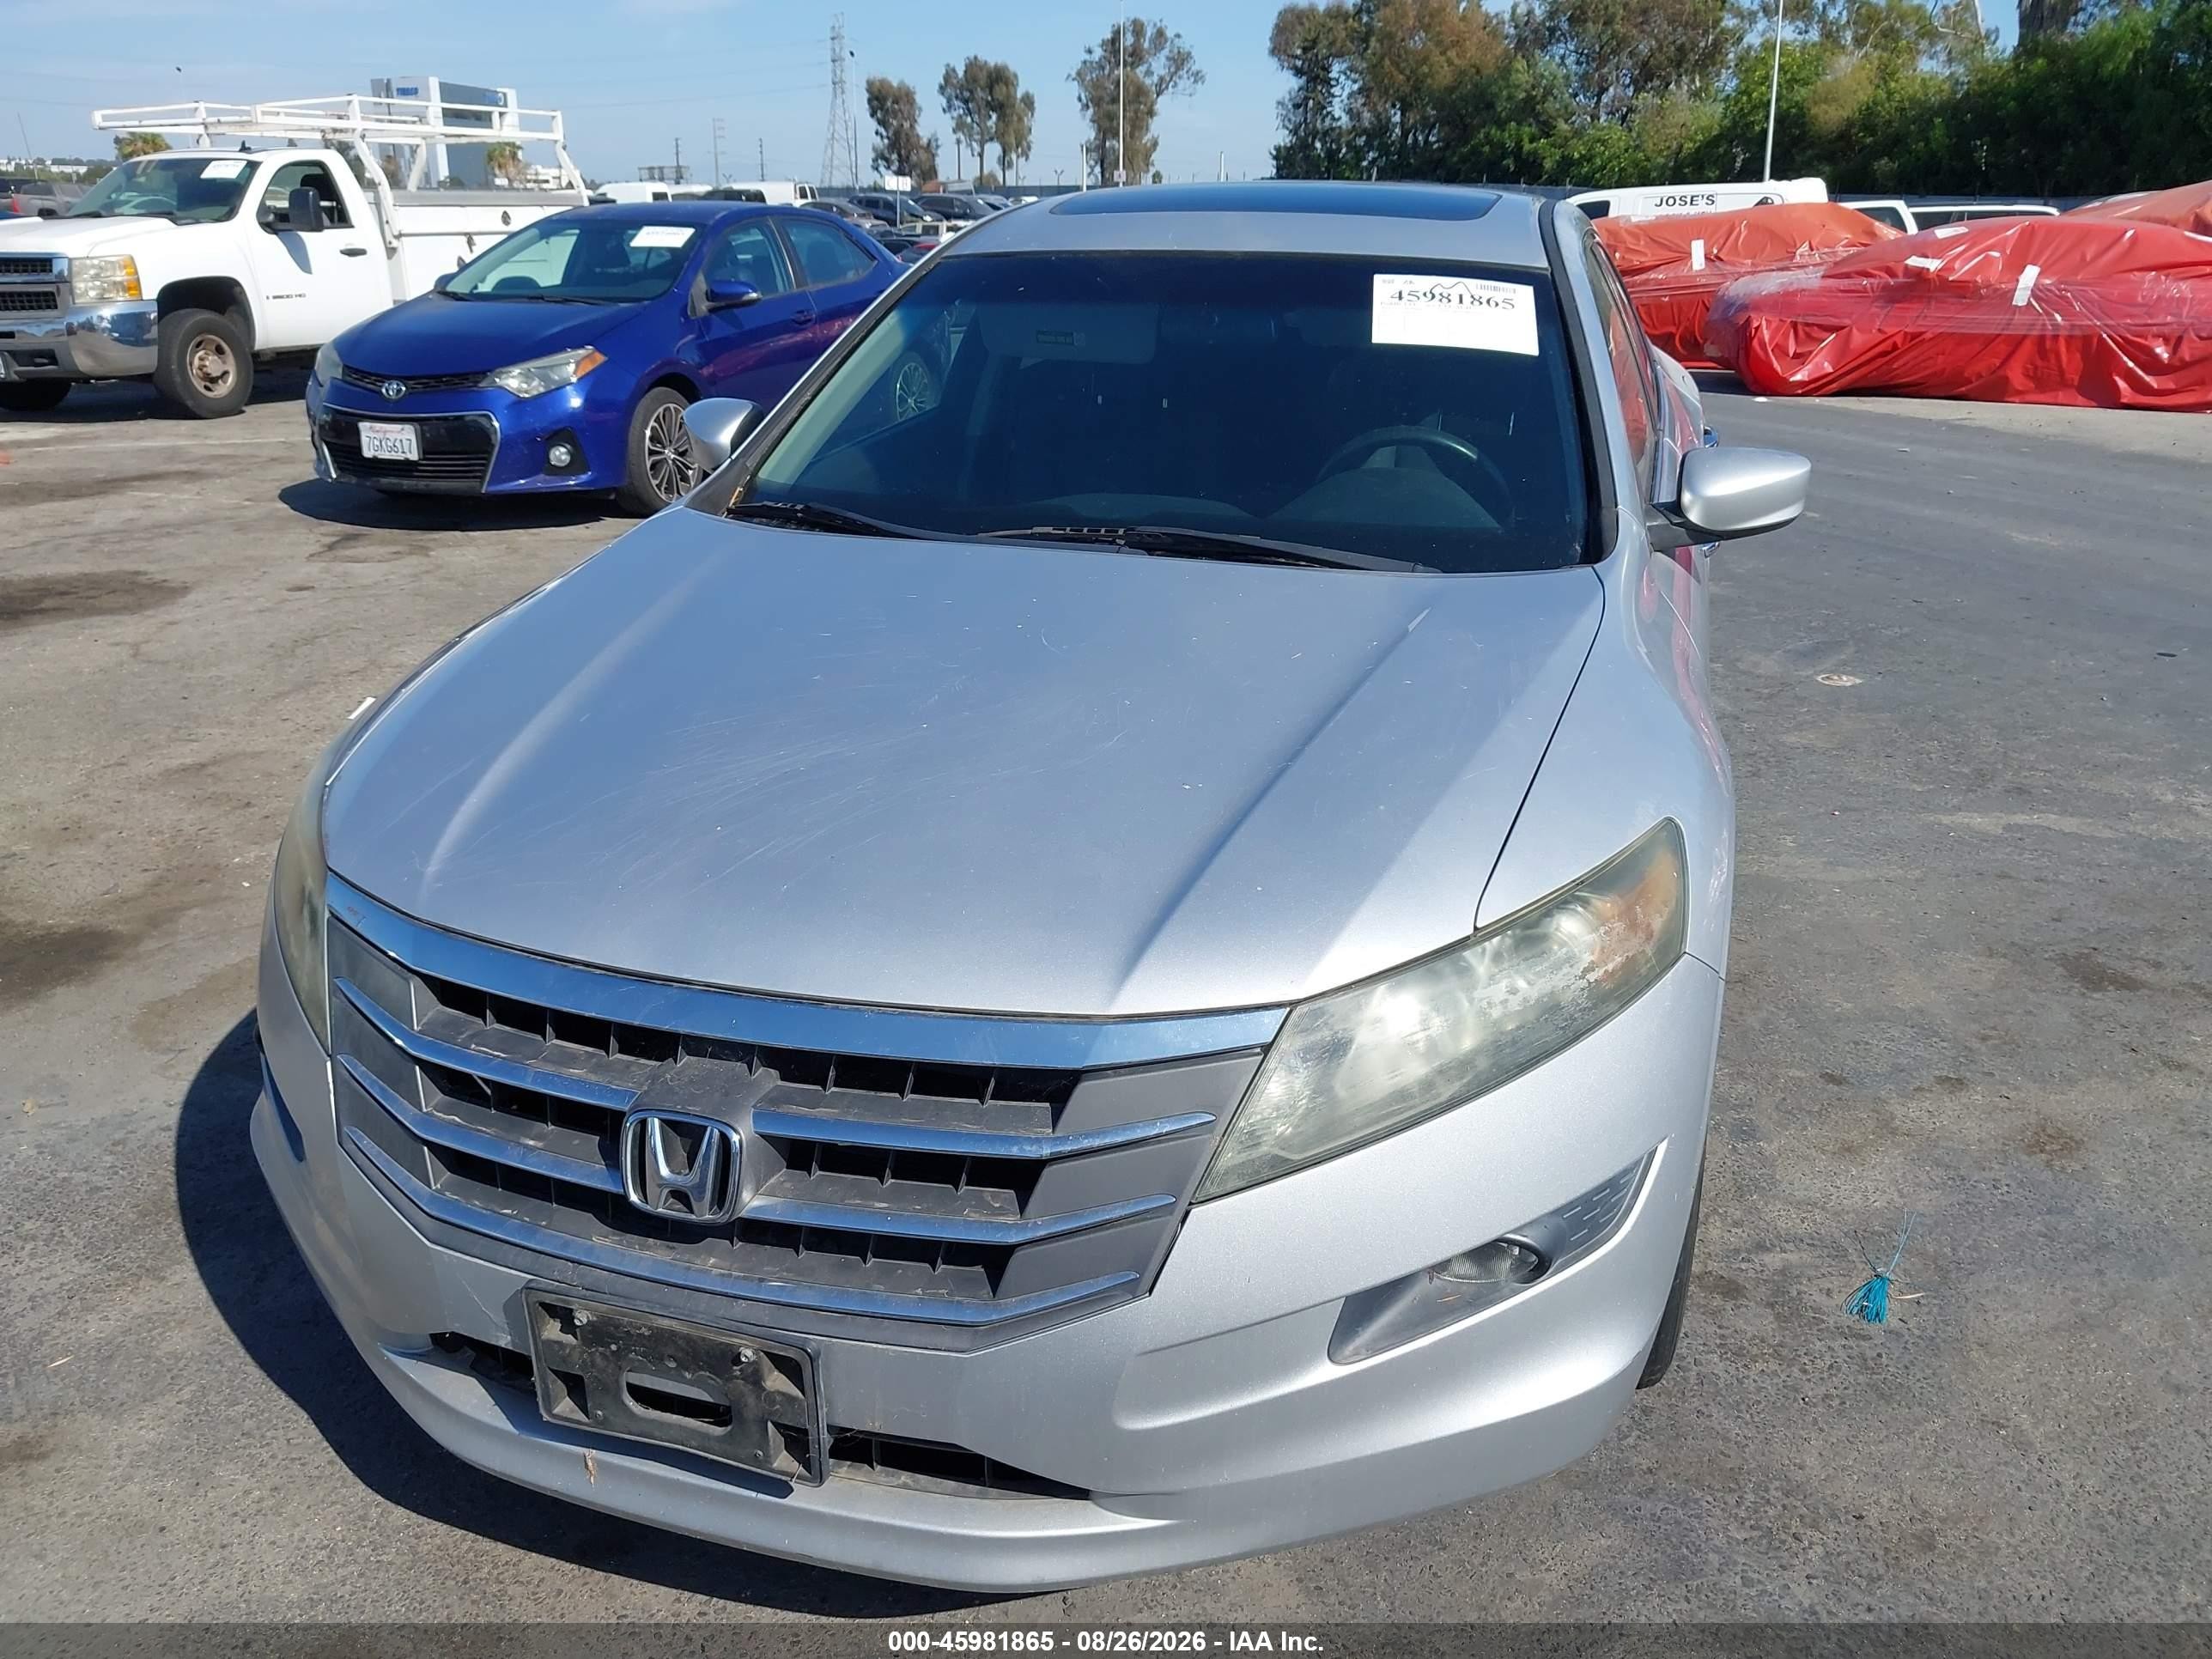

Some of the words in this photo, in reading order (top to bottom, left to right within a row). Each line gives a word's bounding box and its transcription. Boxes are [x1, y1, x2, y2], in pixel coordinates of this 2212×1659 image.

[1654, 194, 1716, 207] JOSE'S
[1389, 289, 1516, 310] 45981865
[365, 435, 413, 454] 7GKG617
